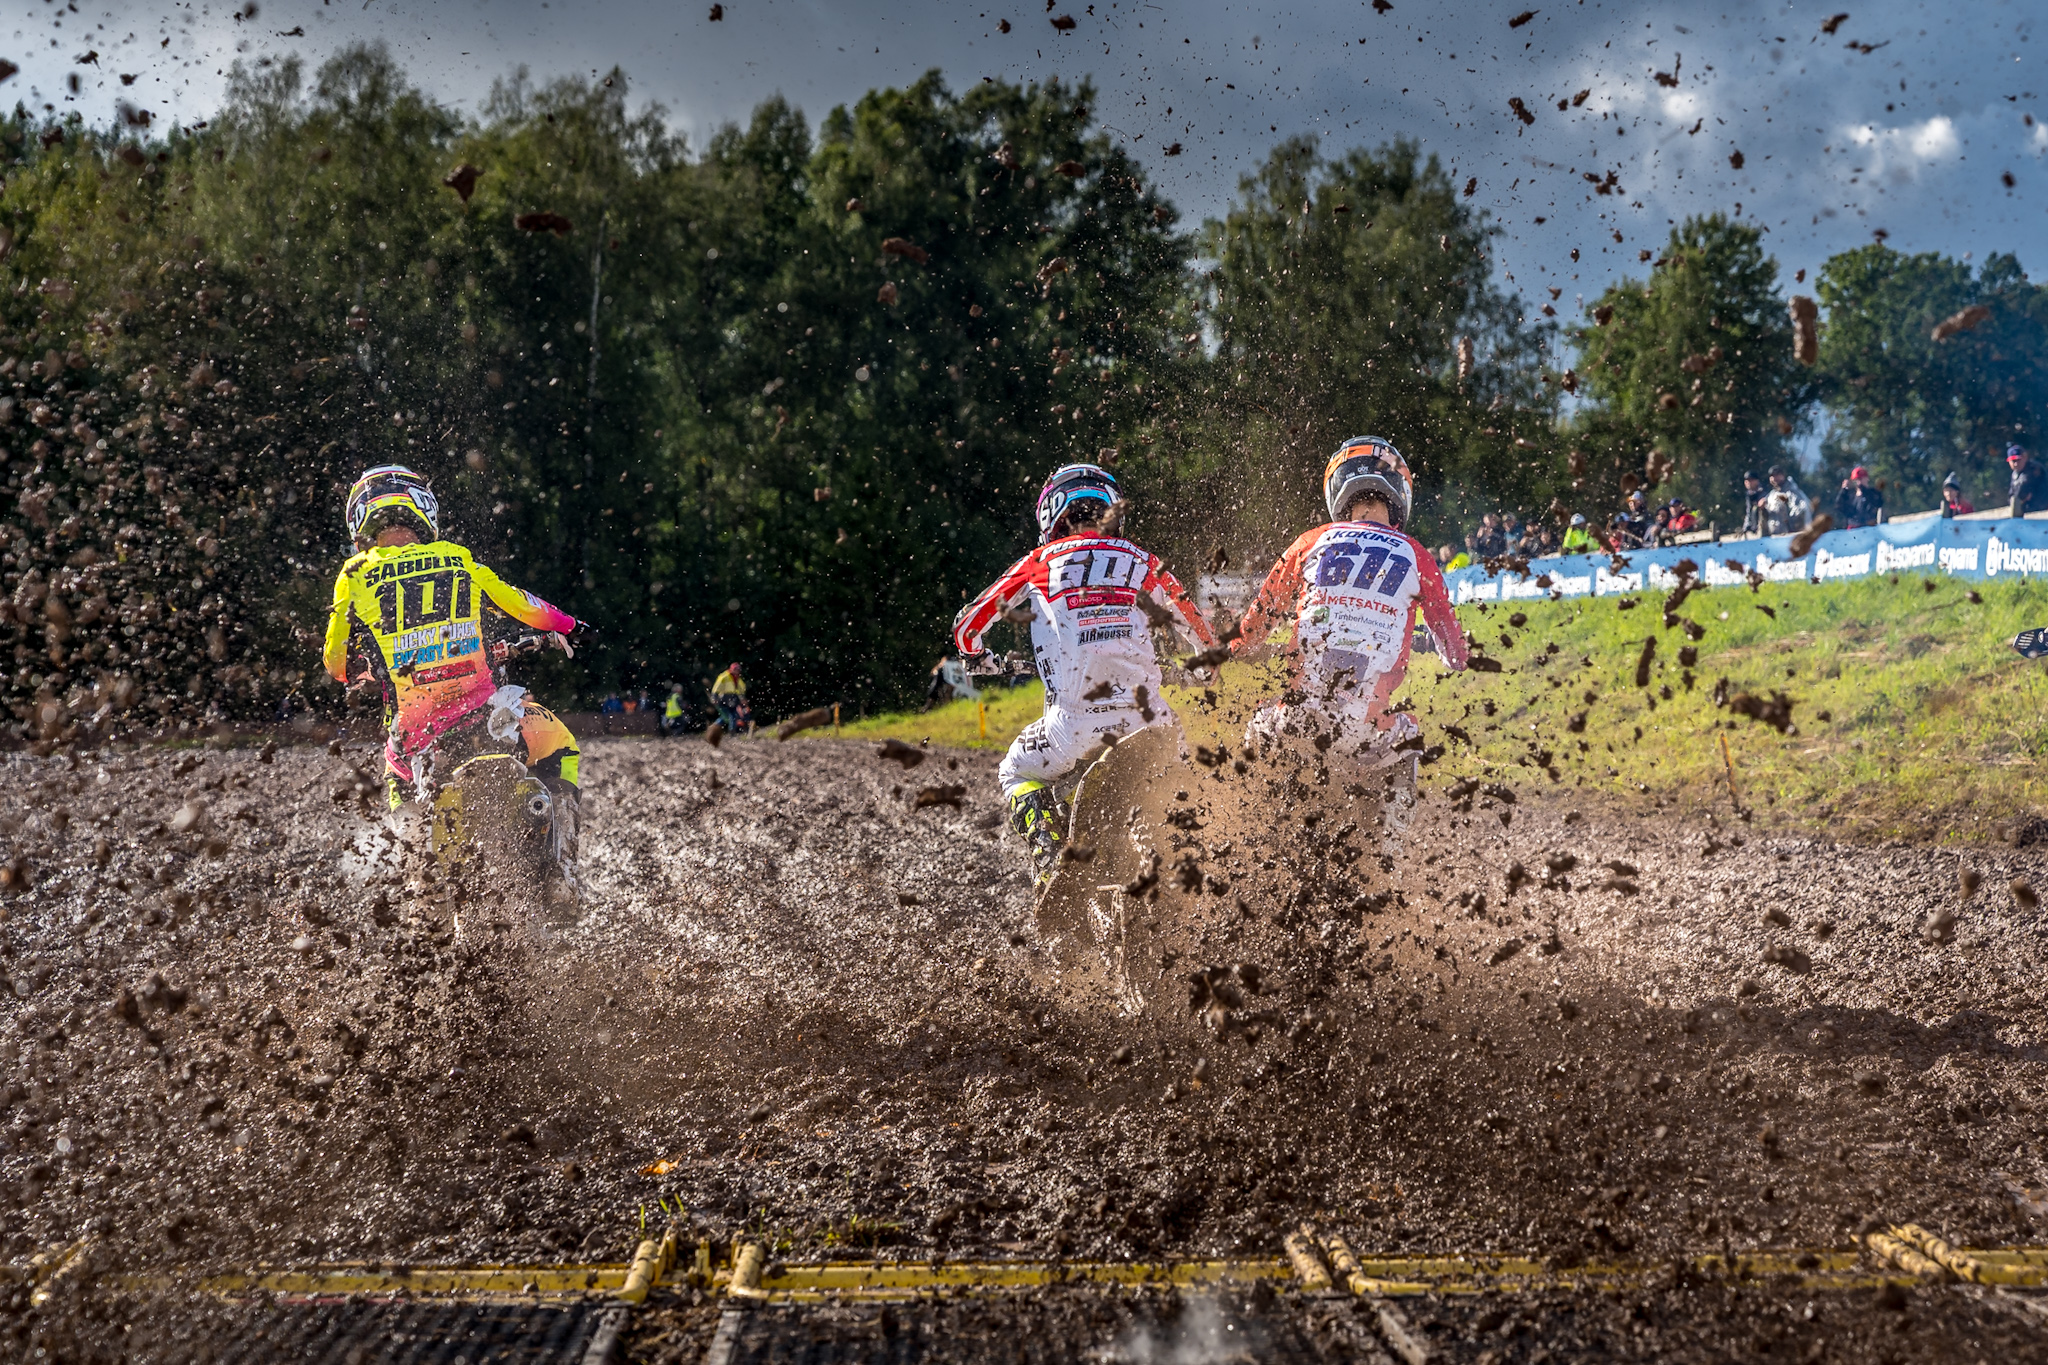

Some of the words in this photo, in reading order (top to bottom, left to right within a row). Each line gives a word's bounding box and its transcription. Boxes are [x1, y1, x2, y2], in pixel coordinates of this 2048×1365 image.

[1333, 530, 1403, 548] KOKINS
[364, 556, 465, 588] SABULIS
[1048, 549, 1150, 598] 601
[1315, 542, 1412, 598] 611
[375, 569, 471, 636] 101
[1327, 595, 1399, 617] METSATEK
[393, 627, 436, 652] LUCKY
[1080, 630, 1131, 644] AIRMOUSSE
